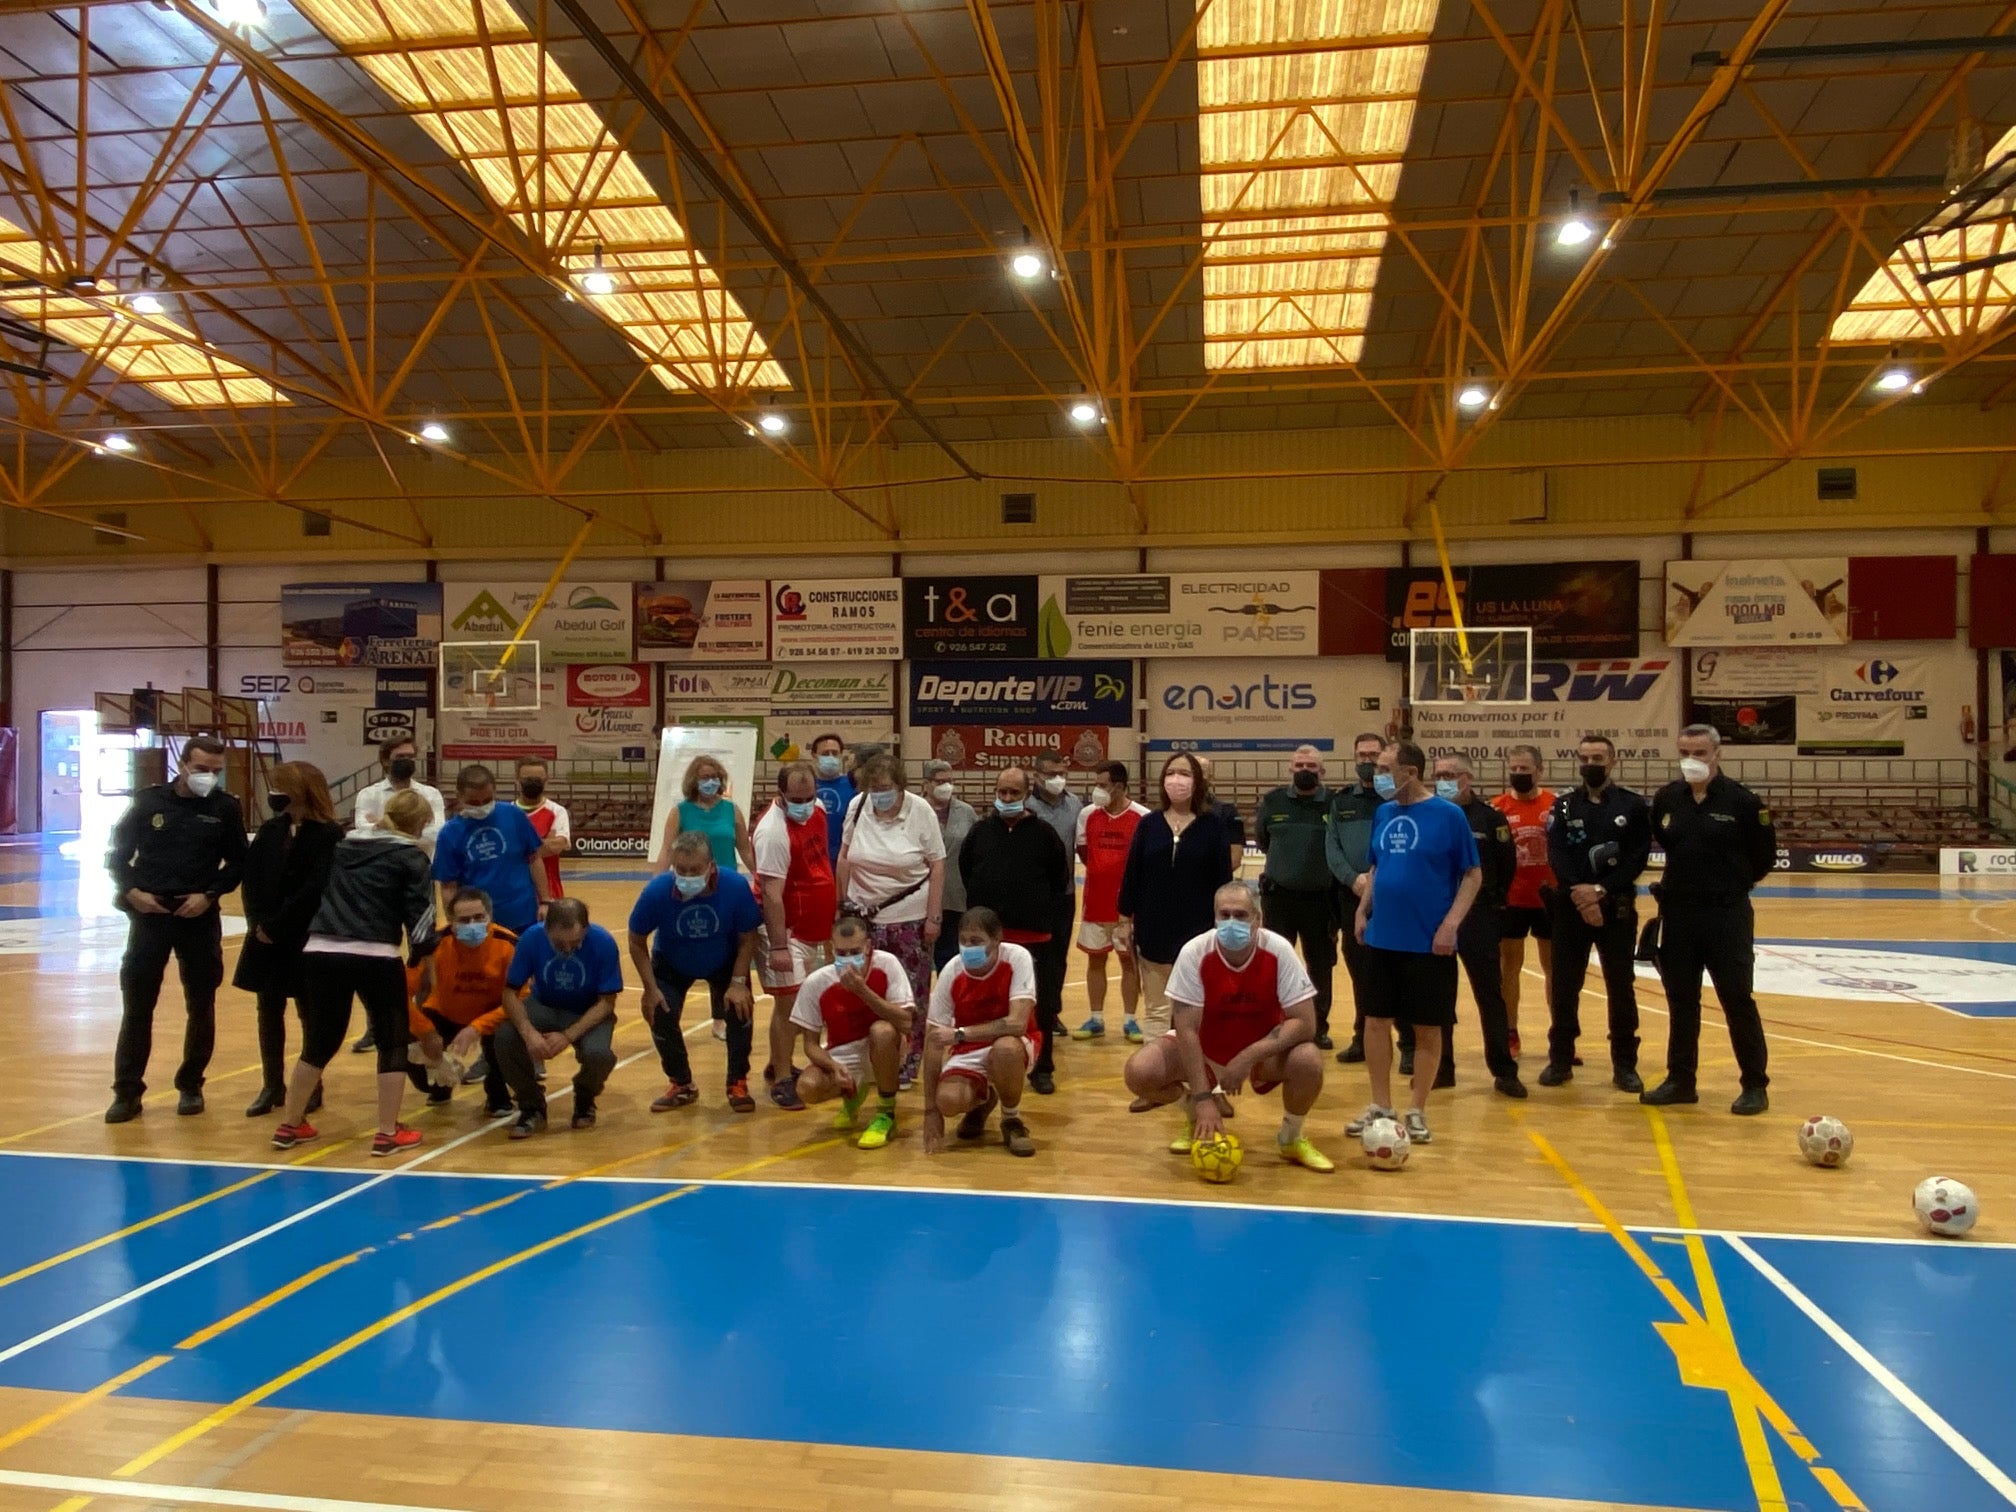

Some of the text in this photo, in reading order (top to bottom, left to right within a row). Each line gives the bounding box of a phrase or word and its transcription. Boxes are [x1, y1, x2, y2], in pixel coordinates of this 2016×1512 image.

[1181, 582, 1290, 594] ELECTRICIDAD
[809, 590, 898, 602] CONSTRUCCIONES
[832, 606, 875, 618] RAMOS
[1725, 603, 1786, 616] 1000 MB
[464, 621, 504, 632] Abedul
[555, 619, 626, 631] Abedul Golf
[915, 626, 1028, 638] centro de idiomas
[1223, 626, 1306, 642] PARES
[367, 650, 437, 664] ARENAL
[240, 676, 291, 693] SER
[584, 674, 617, 682] MOTOR
[771, 669, 861, 694] Decoman
[1419, 662, 1669, 701] MRW
[917, 675, 1083, 706] DeporteVIP
[1163, 674, 1317, 710] enartis
[1830, 688, 1925, 701] Carrefour
[372, 716, 407, 724] ONDA
[1418, 710, 1443, 721] Nos
[1448, 711, 1518, 721] movemos
[1522, 711, 1548, 724] por
[495, 728, 505, 737] TU
[508, 728, 529, 737] CITA
[984, 727, 1061, 749] Racing
[1815, 854, 1864, 864] VULCO
